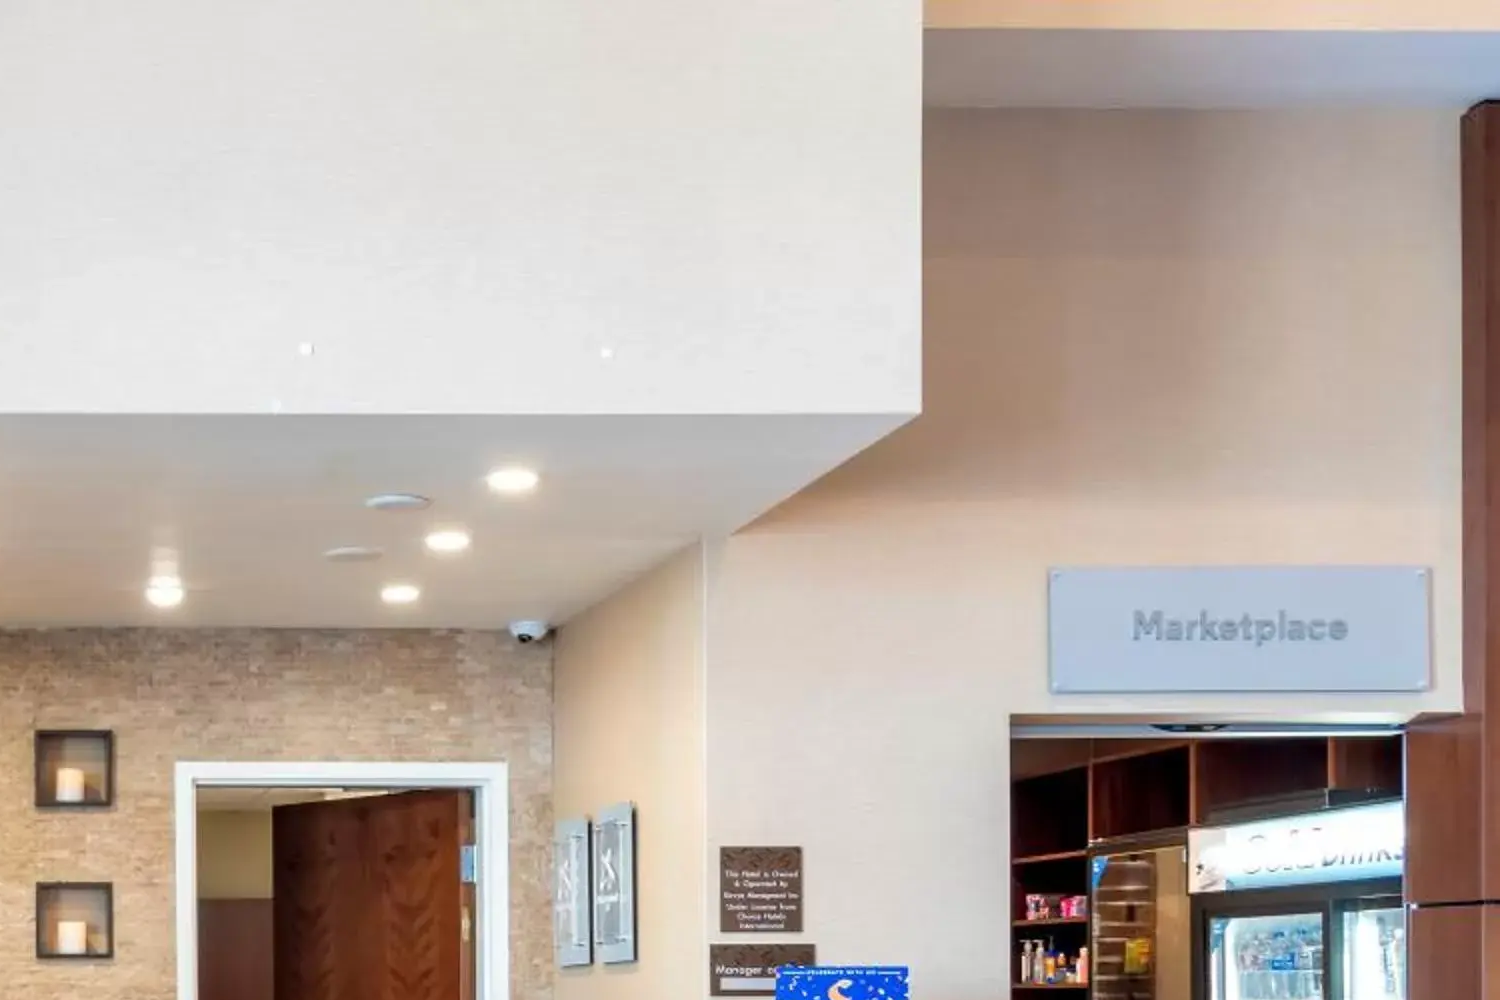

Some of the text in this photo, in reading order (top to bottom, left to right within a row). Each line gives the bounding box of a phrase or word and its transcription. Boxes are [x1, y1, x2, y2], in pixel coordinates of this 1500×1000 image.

[1132, 609, 1349, 647] Marketplace
[771, 869, 799, 878] Owned
[715, 964, 762, 977] Manager
